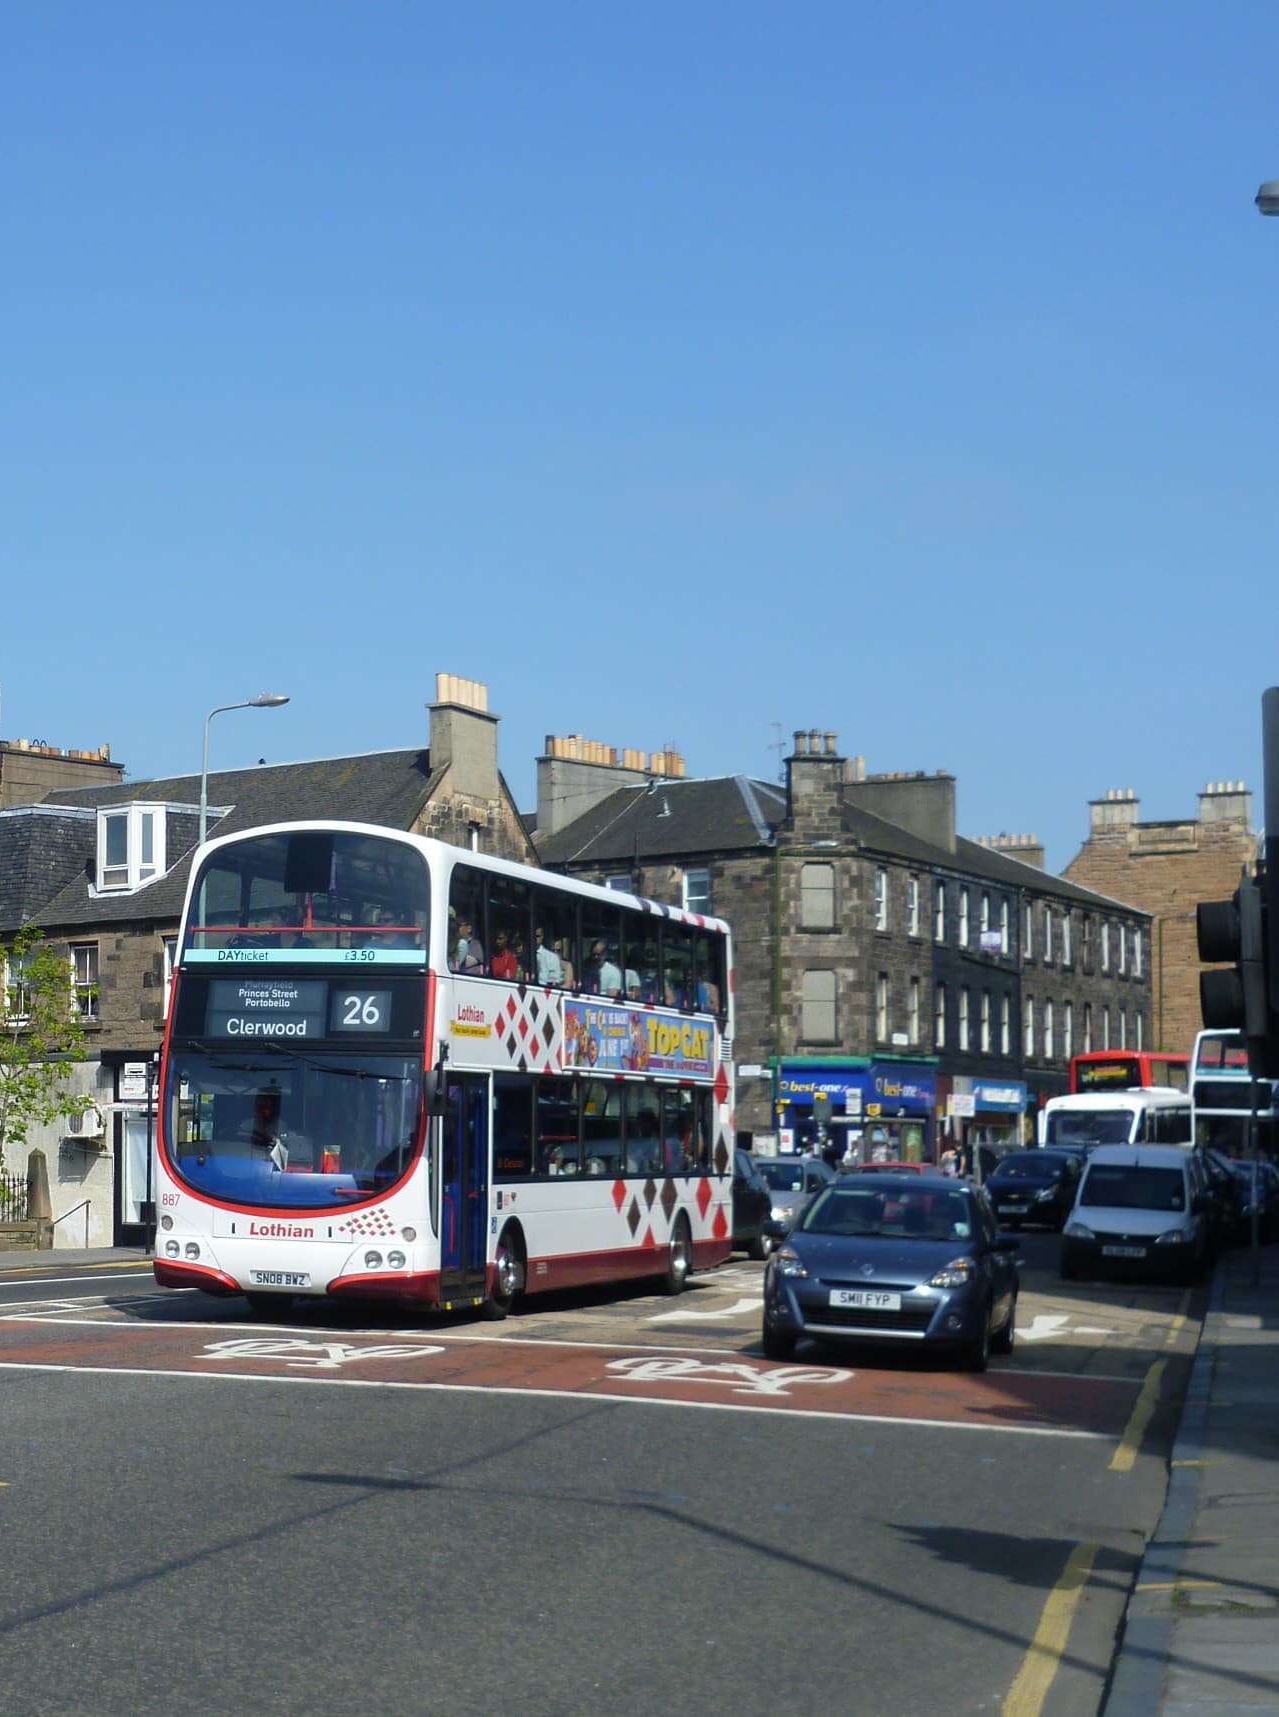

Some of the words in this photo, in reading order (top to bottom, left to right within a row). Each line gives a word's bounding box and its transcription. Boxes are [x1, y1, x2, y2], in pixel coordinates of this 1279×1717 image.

[217, 950, 269, 961] DAYticket
[344, 950, 376, 961] £3.50
[238, 988, 270, 998] Princes
[271, 989, 298, 998] Street
[245, 998, 291, 1008] Portobello
[342, 996, 380, 1026] 26
[457, 1003, 485, 1023] Lothian
[226, 1018, 308, 1036] Clerwood
[162, 1193, 181, 1206] 887
[249, 1222, 314, 1238] Lothian
[256, 1272, 283, 1285] SN08
[284, 1274, 306, 1286] BWZ
[865, 1293, 891, 1306] FYP
